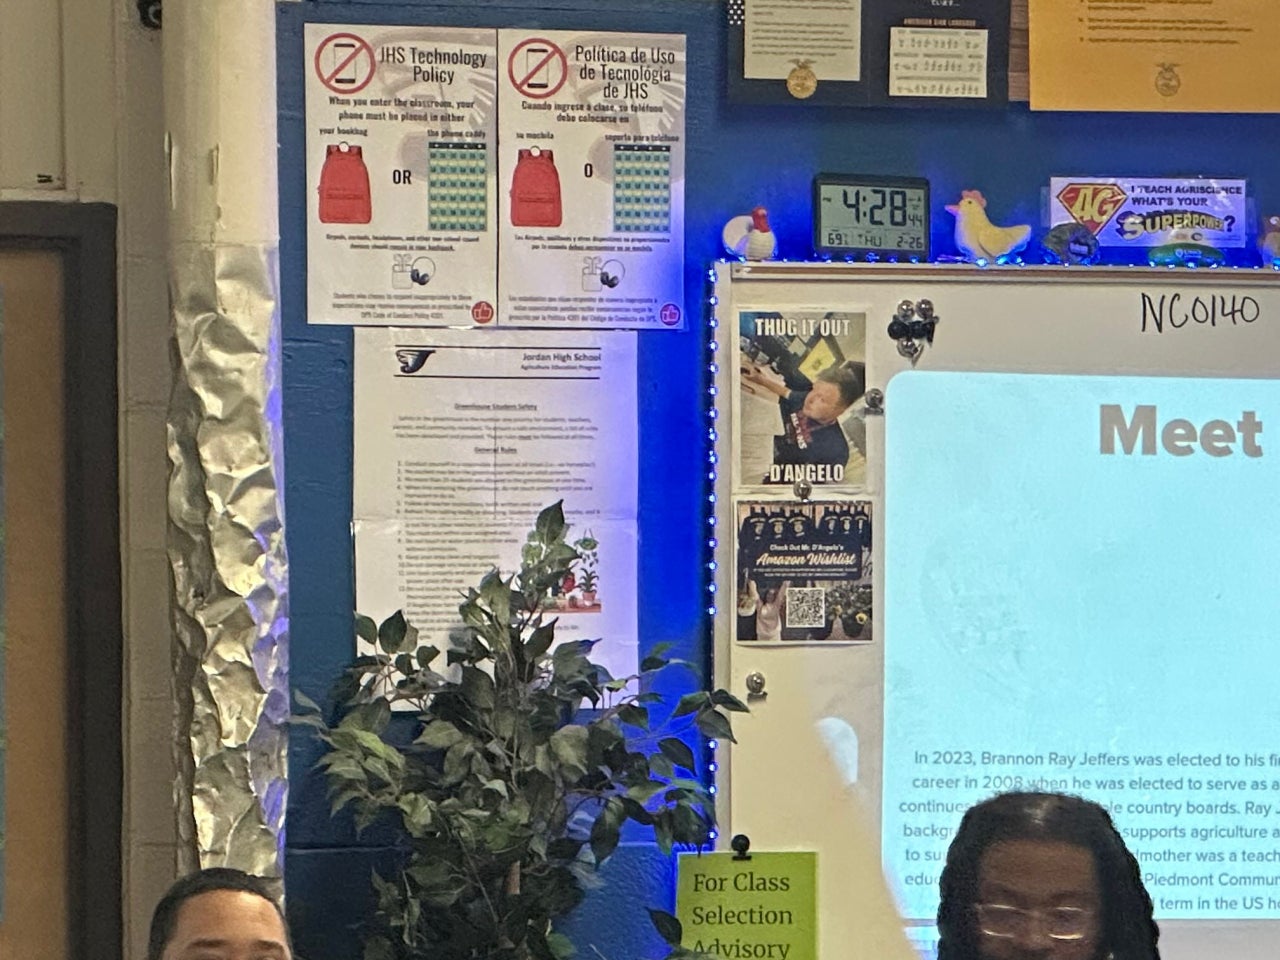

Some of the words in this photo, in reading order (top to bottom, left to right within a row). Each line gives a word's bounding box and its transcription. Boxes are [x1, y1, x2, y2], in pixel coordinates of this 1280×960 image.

[380, 46, 406, 64] JHS
[410, 47, 487, 68] Technology
[575, 45, 627, 63] Política
[631, 47, 647, 63] de
[651, 47, 675, 64] Uso
[413, 65, 455, 85] Policy
[580, 64, 595, 80] de
[603, 83, 619, 99] de
[623, 83, 649, 99] JHS
[329, 96, 350, 106] When
[353, 98, 367, 108] you
[370, 98, 391, 106] enter
[394, 98, 408, 106] the
[457, 101, 475, 109] your
[339, 111, 363, 121] phone
[366, 112, 386, 121] must
[389, 112, 399, 121] be
[401, 112, 428, 122] placed
[430, 113, 438, 121] in
[440, 113, 465, 122] either
[393, 169, 412, 185] OR
[584, 163, 594, 177] O
[1131, 185, 1135, 193] I
[1139, 185, 1172, 194] TEACH
[843, 189, 907, 226] 4:28
[1071, 186, 1115, 222] AG
[1132, 197, 1175, 206] WHAT'S
[1177, 197, 1209, 207] YOUR
[908, 214, 922, 226] 44
[858, 233, 882, 247] THU
[897, 236, 923, 249] 2-26
[755, 319, 797, 336] THUG
[802, 319, 816, 336] IT
[820, 319, 850, 336] OUT
[523, 353, 551, 361] Jordan
[553, 353, 572, 363] High
[574, 353, 602, 361] School
[1099, 404, 1263, 458] Meet
[770, 463, 844, 482] D'ANGELO
[756, 553, 806, 566] Amazon
[806, 552, 856, 566] Wishlist
[914, 751, 927, 764] In
[932, 751, 976, 766] 2023,
[980, 751, 1043, 765] Brannon
[1048, 752, 1076, 769] Ray
[1079, 752, 1129, 766] Jeffers
[1133, 756, 1162, 766] was
[1166, 753, 1221, 766] elected
[1225, 755, 1240, 766] to
[1244, 754, 1265, 766] his
[693, 873, 728, 892] For
[733, 872, 790, 892] Class
[1159, 898, 1193, 909] term
[1197, 897, 1210, 909] in
[1213, 897, 1238, 909] the
[1241, 897, 1263, 909] US
[692, 905, 793, 925] Selection
